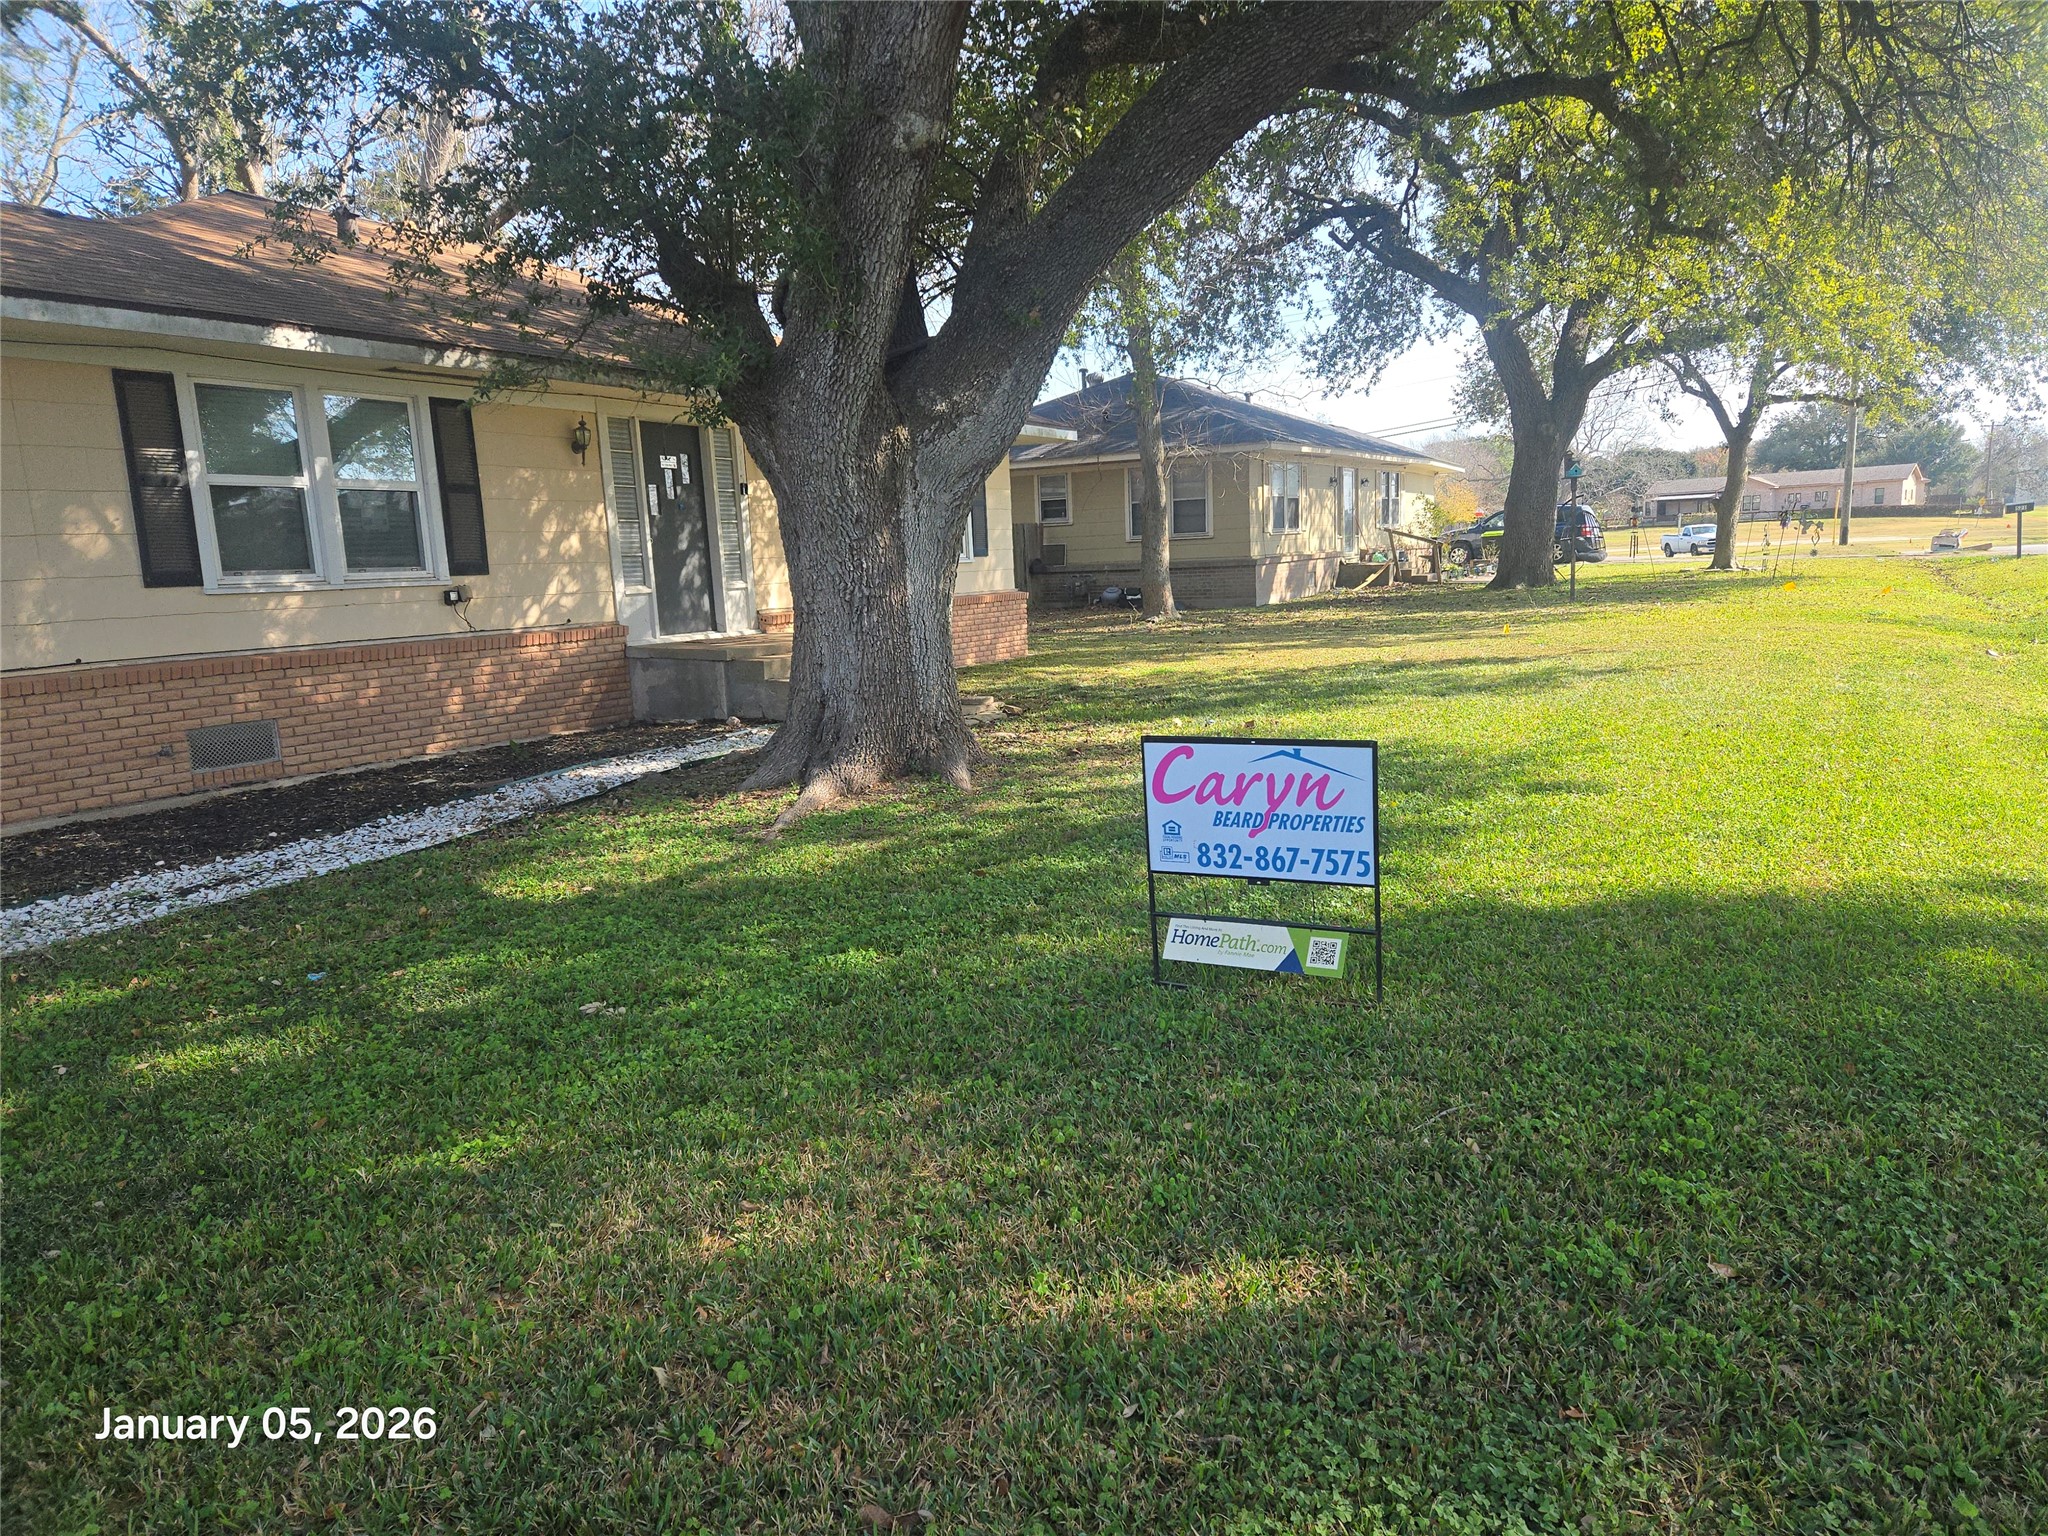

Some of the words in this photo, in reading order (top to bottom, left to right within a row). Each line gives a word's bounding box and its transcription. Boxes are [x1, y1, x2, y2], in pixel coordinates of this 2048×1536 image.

[1152, 745, 1345, 838] Caryn
[1213, 811, 1264, 829] BEARD
[1268, 812, 1365, 833] PROPERTIES
[1197, 843, 1370, 877] 832-867-7575
